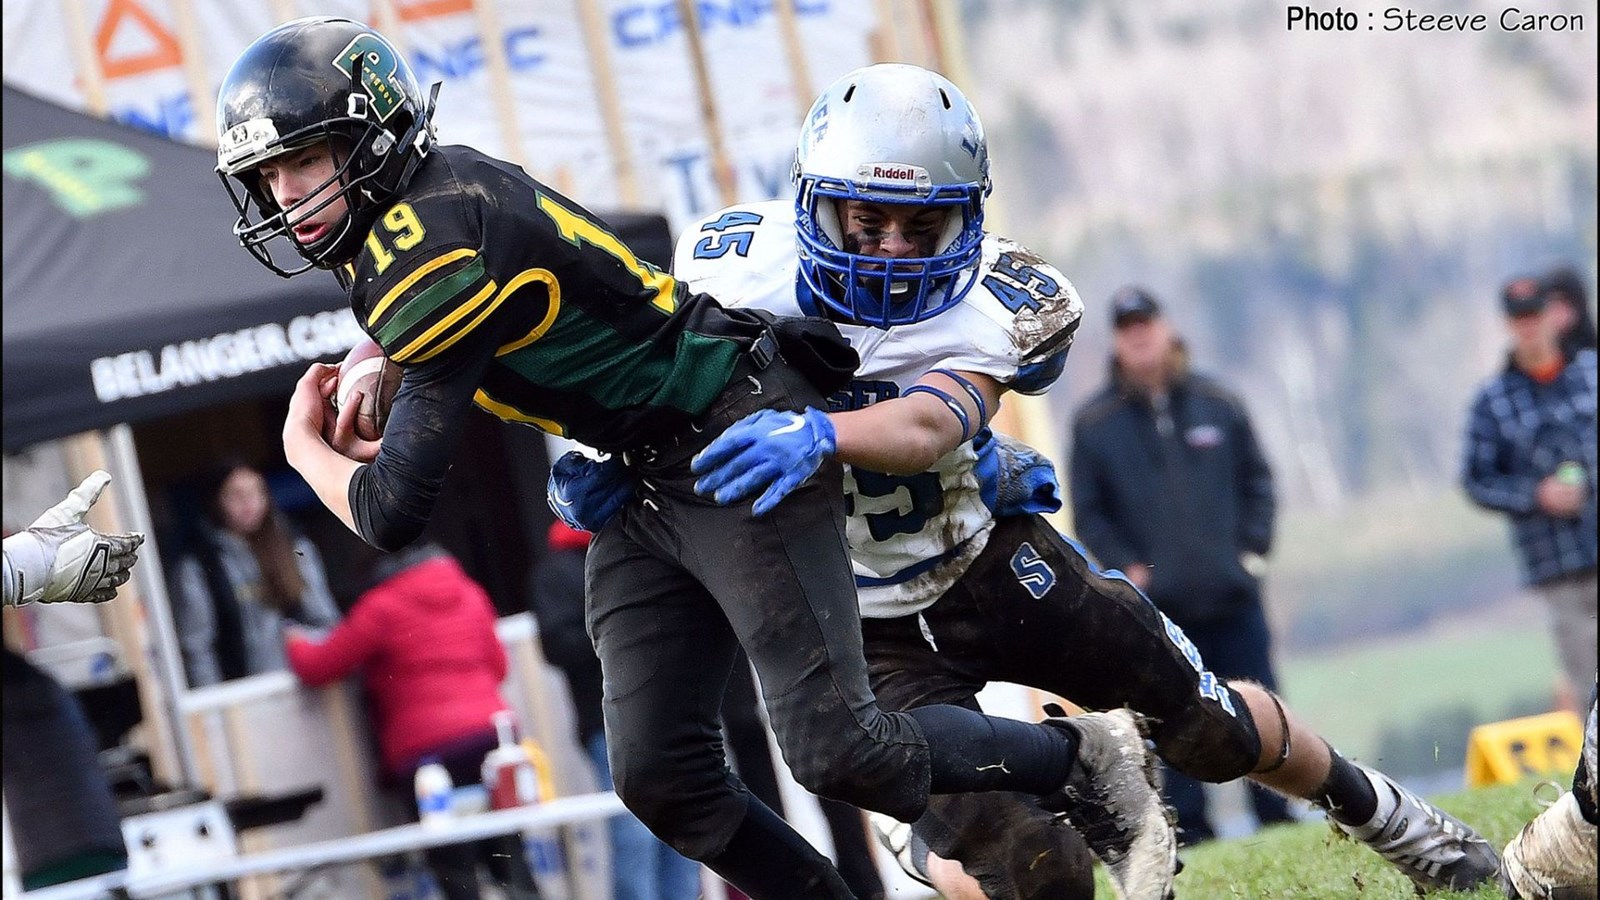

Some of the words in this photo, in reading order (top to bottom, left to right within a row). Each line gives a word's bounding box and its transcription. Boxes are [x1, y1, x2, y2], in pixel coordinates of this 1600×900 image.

[873, 166, 914, 180] Riddell
[364, 202, 427, 276] 19
[693, 211, 764, 260] 45
[980, 252, 1060, 315] 45
[1009, 541, 1057, 600] S
